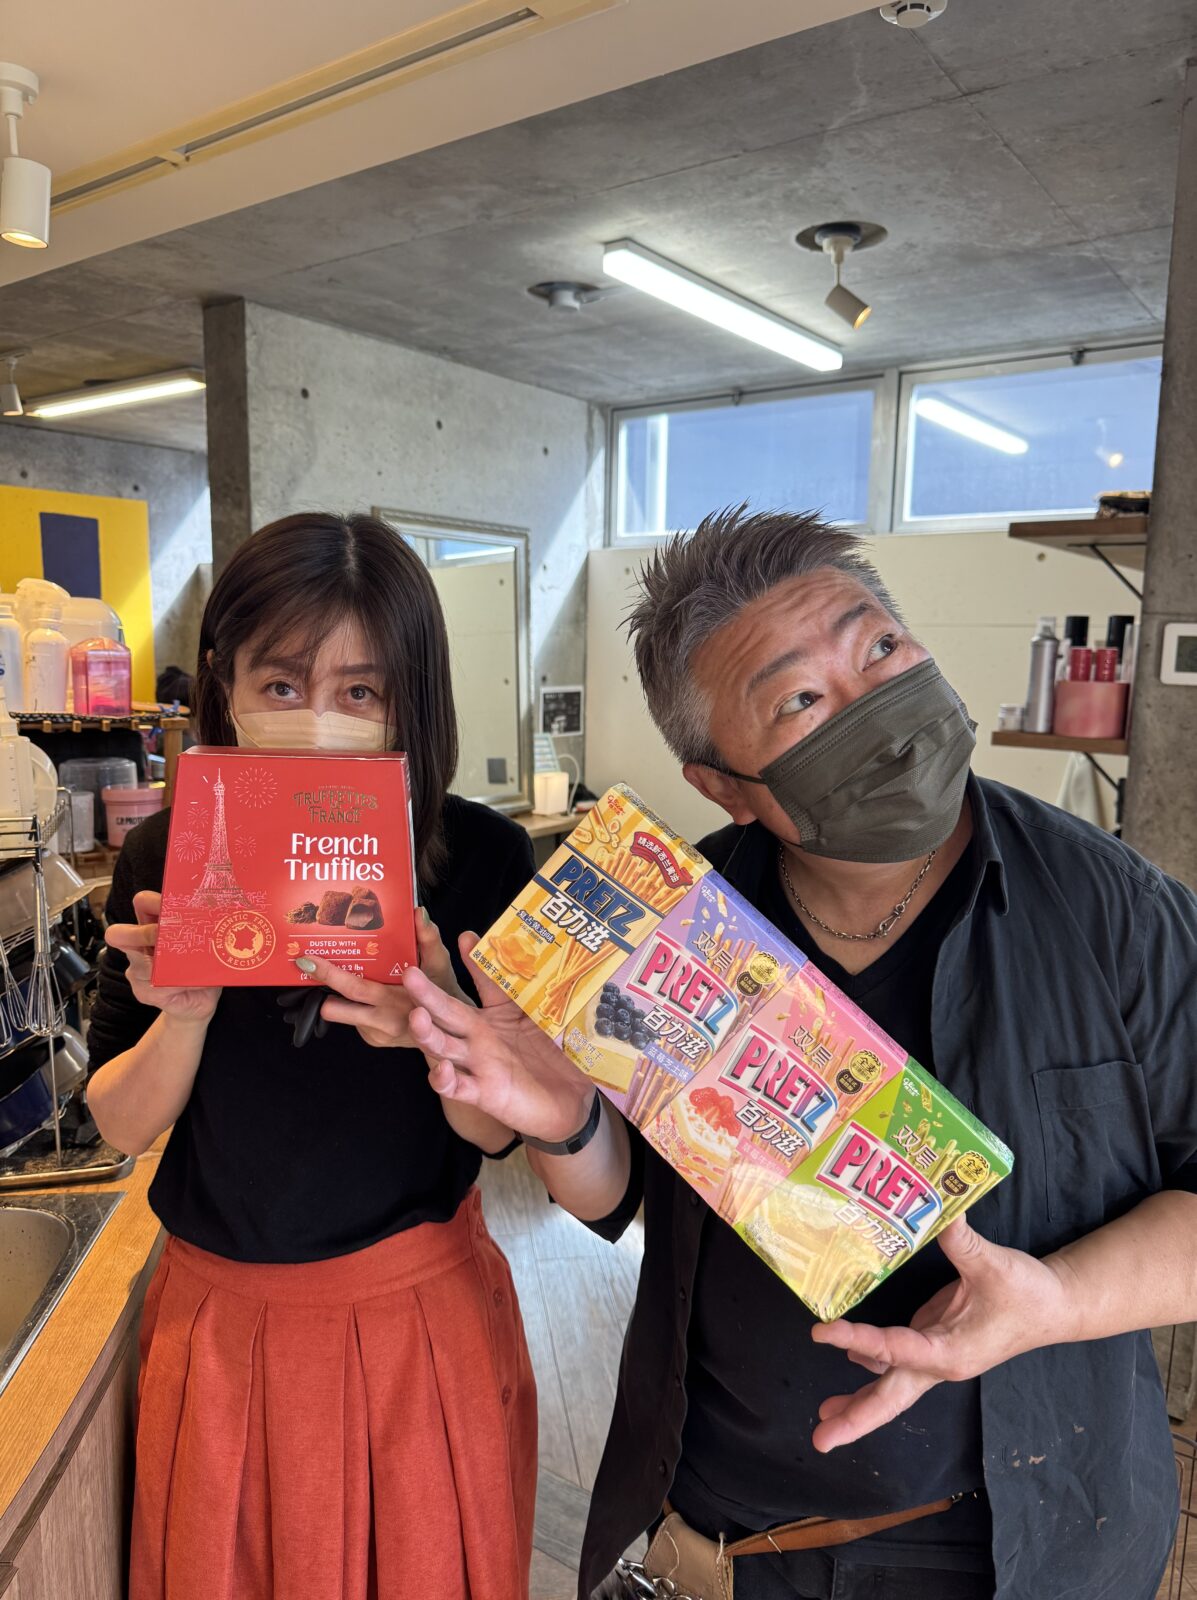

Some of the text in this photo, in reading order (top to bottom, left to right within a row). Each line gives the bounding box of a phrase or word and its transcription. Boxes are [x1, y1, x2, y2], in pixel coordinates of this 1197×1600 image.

[293, 788, 378, 809] TRUFFETTES
[308, 805, 362, 824] FRANCE
[291, 832, 378, 855] French
[283, 856, 385, 881] Truffles
[549, 854, 647, 938] PRETZ
[215, 913, 273, 949] AUTHENTIC FRENCH
[540, 891, 611, 953] 百力滋
[226, 954, 263, 967] RECIPE
[304, 948, 361, 956] COCOA POWDER
[309, 940, 357, 948] DUSTED WITH
[354, 963, 364, 971] lbs
[637, 941, 736, 1036] PRETZ
[642, 1003, 709, 1060] 百力滋
[730, 1035, 834, 1133] PRETZ
[735, 1099, 805, 1158] 百力滋
[829, 1133, 938, 1234] PRETZ
[834, 1198, 908, 1258] 百力滋
